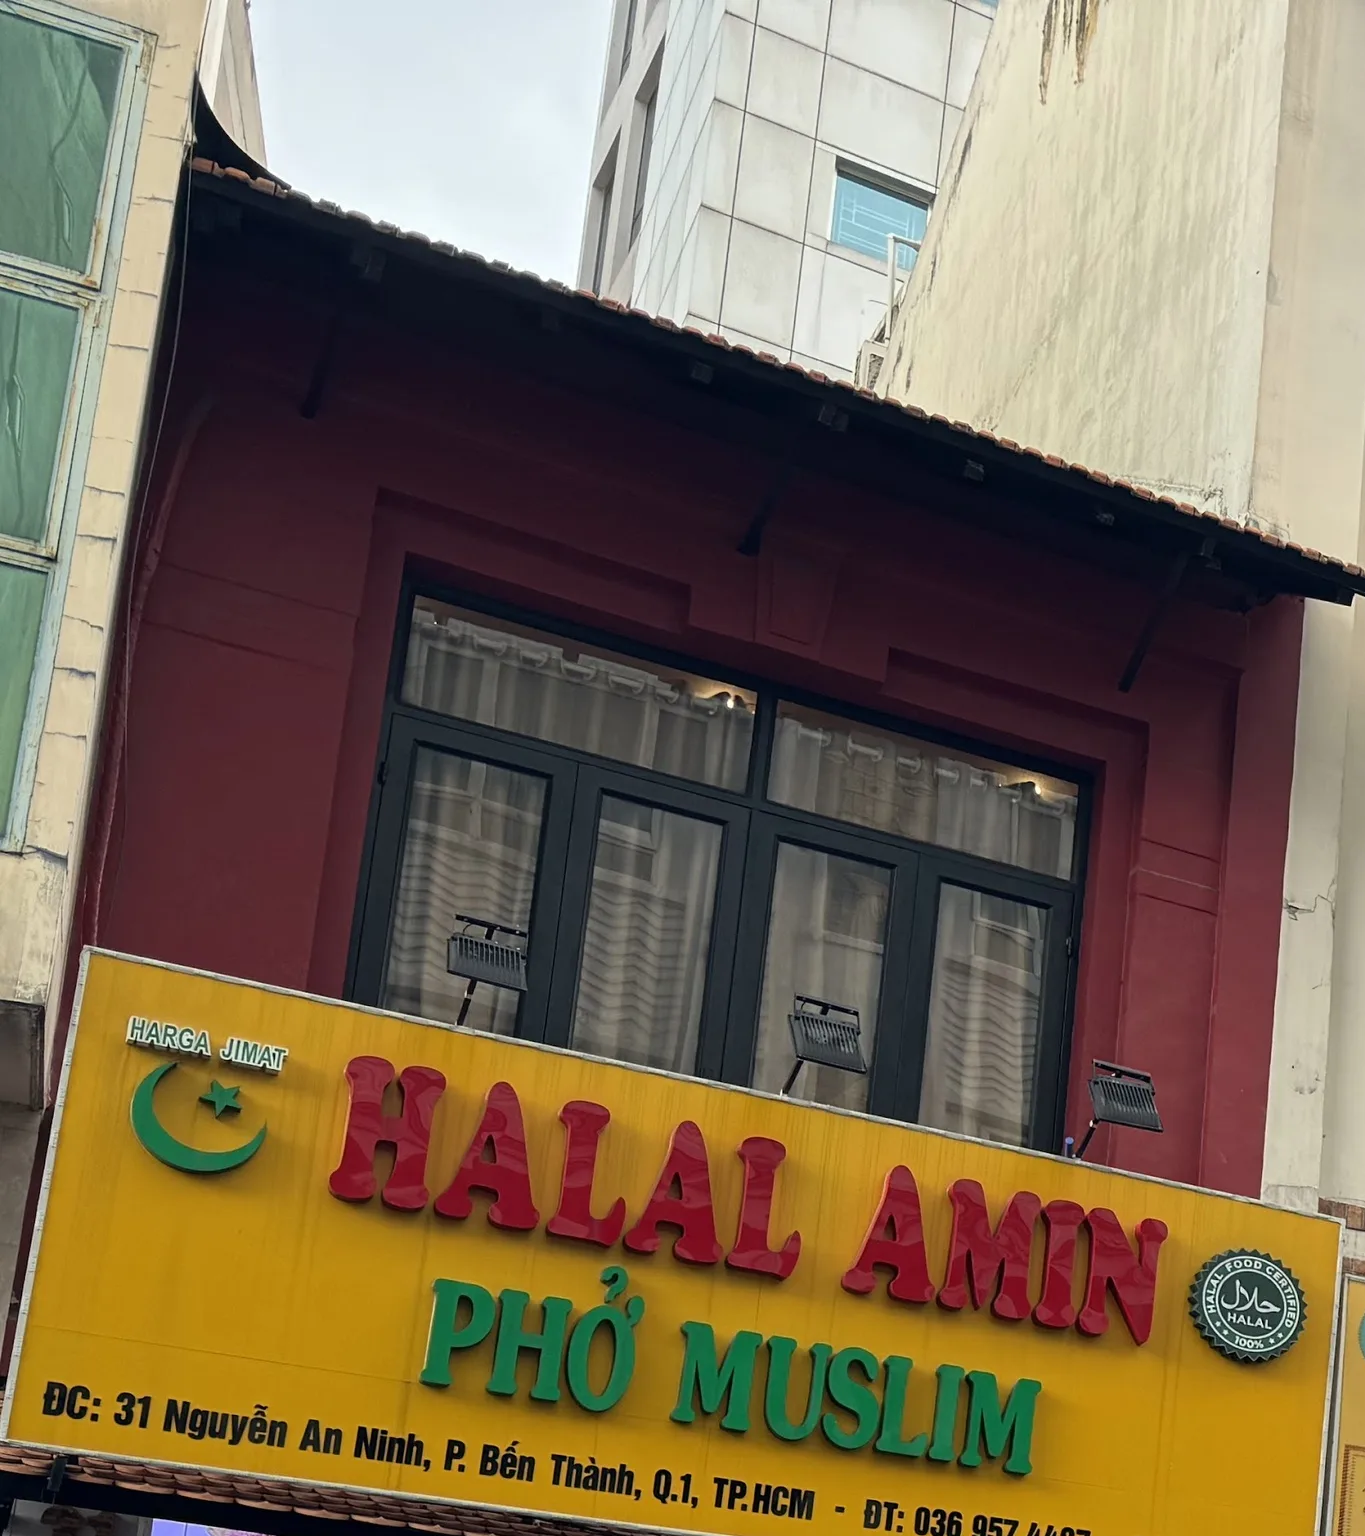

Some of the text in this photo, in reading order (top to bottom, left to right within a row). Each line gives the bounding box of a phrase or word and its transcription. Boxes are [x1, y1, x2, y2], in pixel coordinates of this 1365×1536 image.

[126, 1015, 288, 1073] HARGA JIMAT
[329, 1055, 1169, 1346] HALAL AMIN
[1221, 1279, 1281, 1313] حلال
[1227, 1312, 1272, 1330] HALAL
[419, 1265, 1042, 1476] PHỞ MUSLIM
[1235, 1336, 1264, 1348] 100%
[42, 1381, 102, 1422] ĐC:
[113, 1391, 152, 1429] 31
[162, 1398, 288, 1448] Nguyễn
[299, 1419, 342, 1455] An
[353, 1425, 431, 1472] Ninh,
[443, 1439, 466, 1472] P.
[479, 1440, 535, 1482] Bến
[550, 1453, 641, 1500] Thành,
[652, 1468, 698, 1509] Q.1,
[713, 1476, 815, 1521] TP.HCM
[863, 1498, 904, 1533] ĐT:
